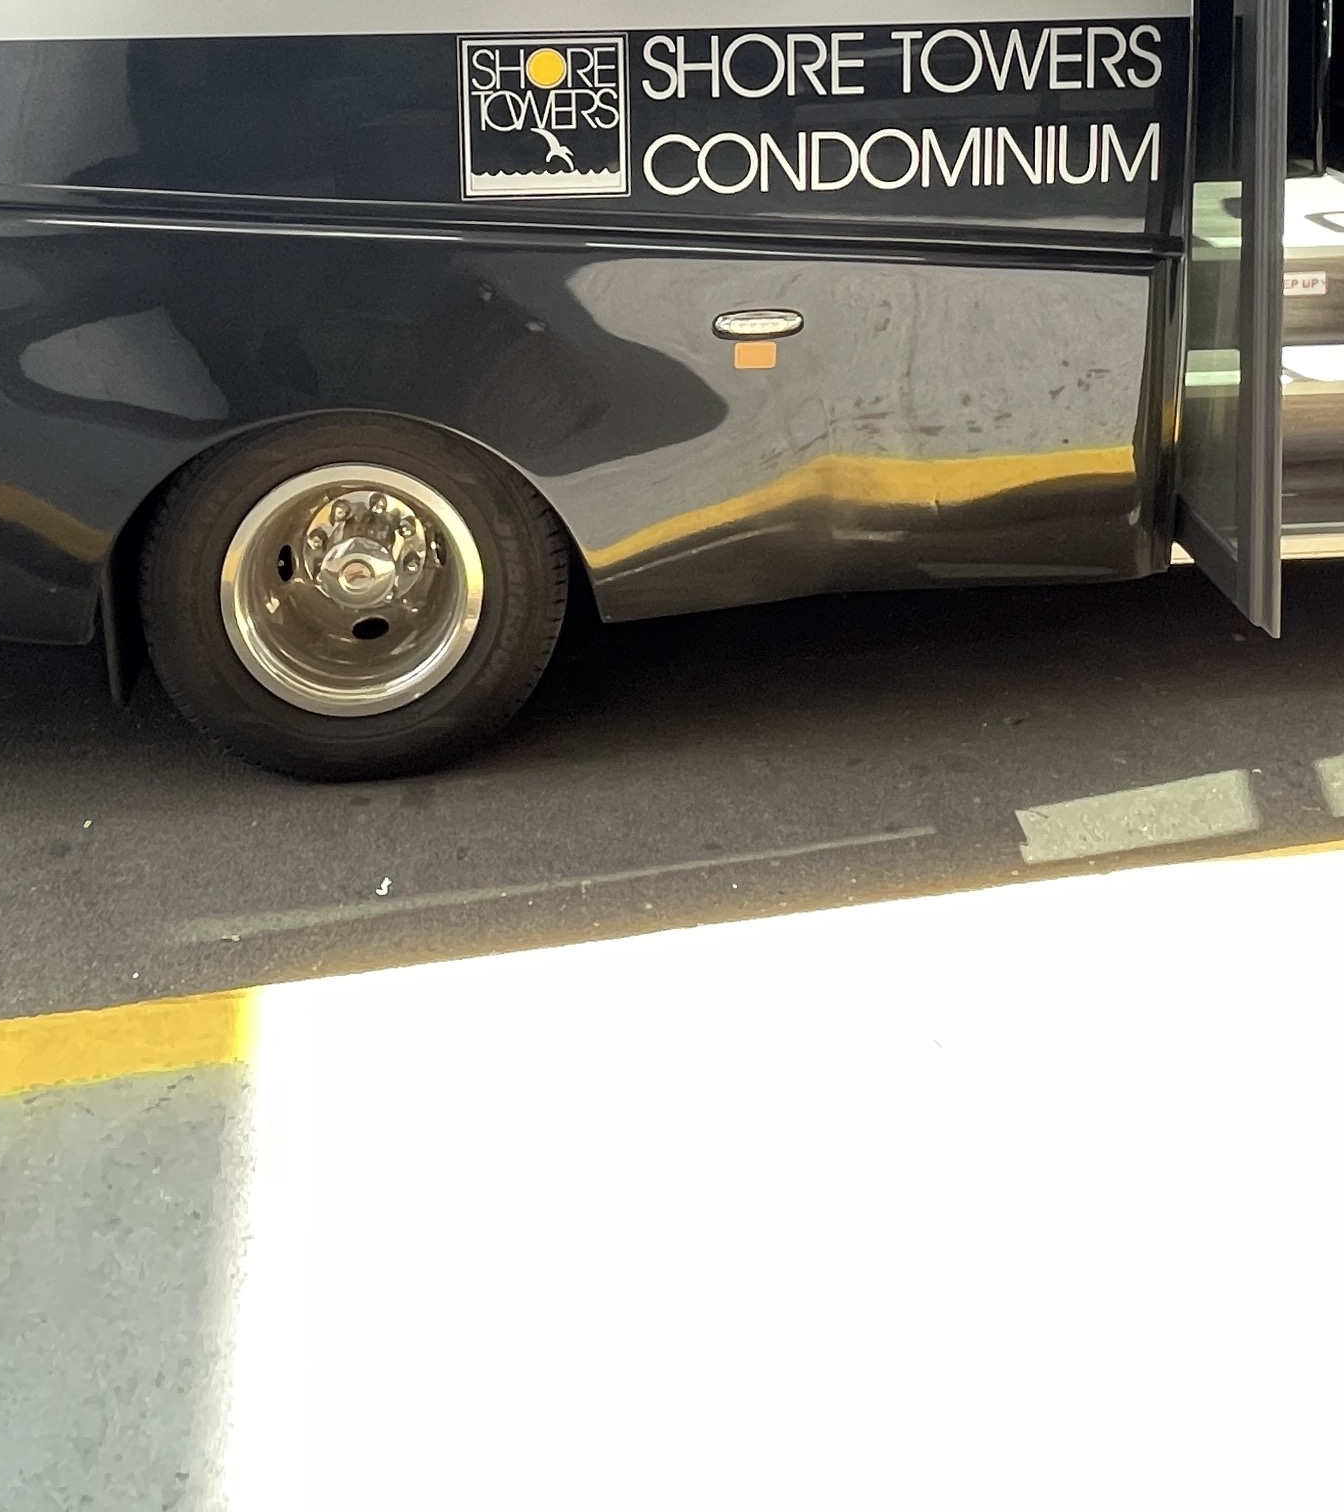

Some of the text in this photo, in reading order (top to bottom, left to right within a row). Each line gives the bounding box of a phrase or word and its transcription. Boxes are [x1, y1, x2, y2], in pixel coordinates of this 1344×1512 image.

[471, 46, 617, 90] SHORE
[642, 25, 1163, 100] SHORE TOWERS
[471, 87, 620, 132] TOWERS
[643, 122, 1160, 196] CONDOMINIUM
[1302, 278, 1319, 289] UP
